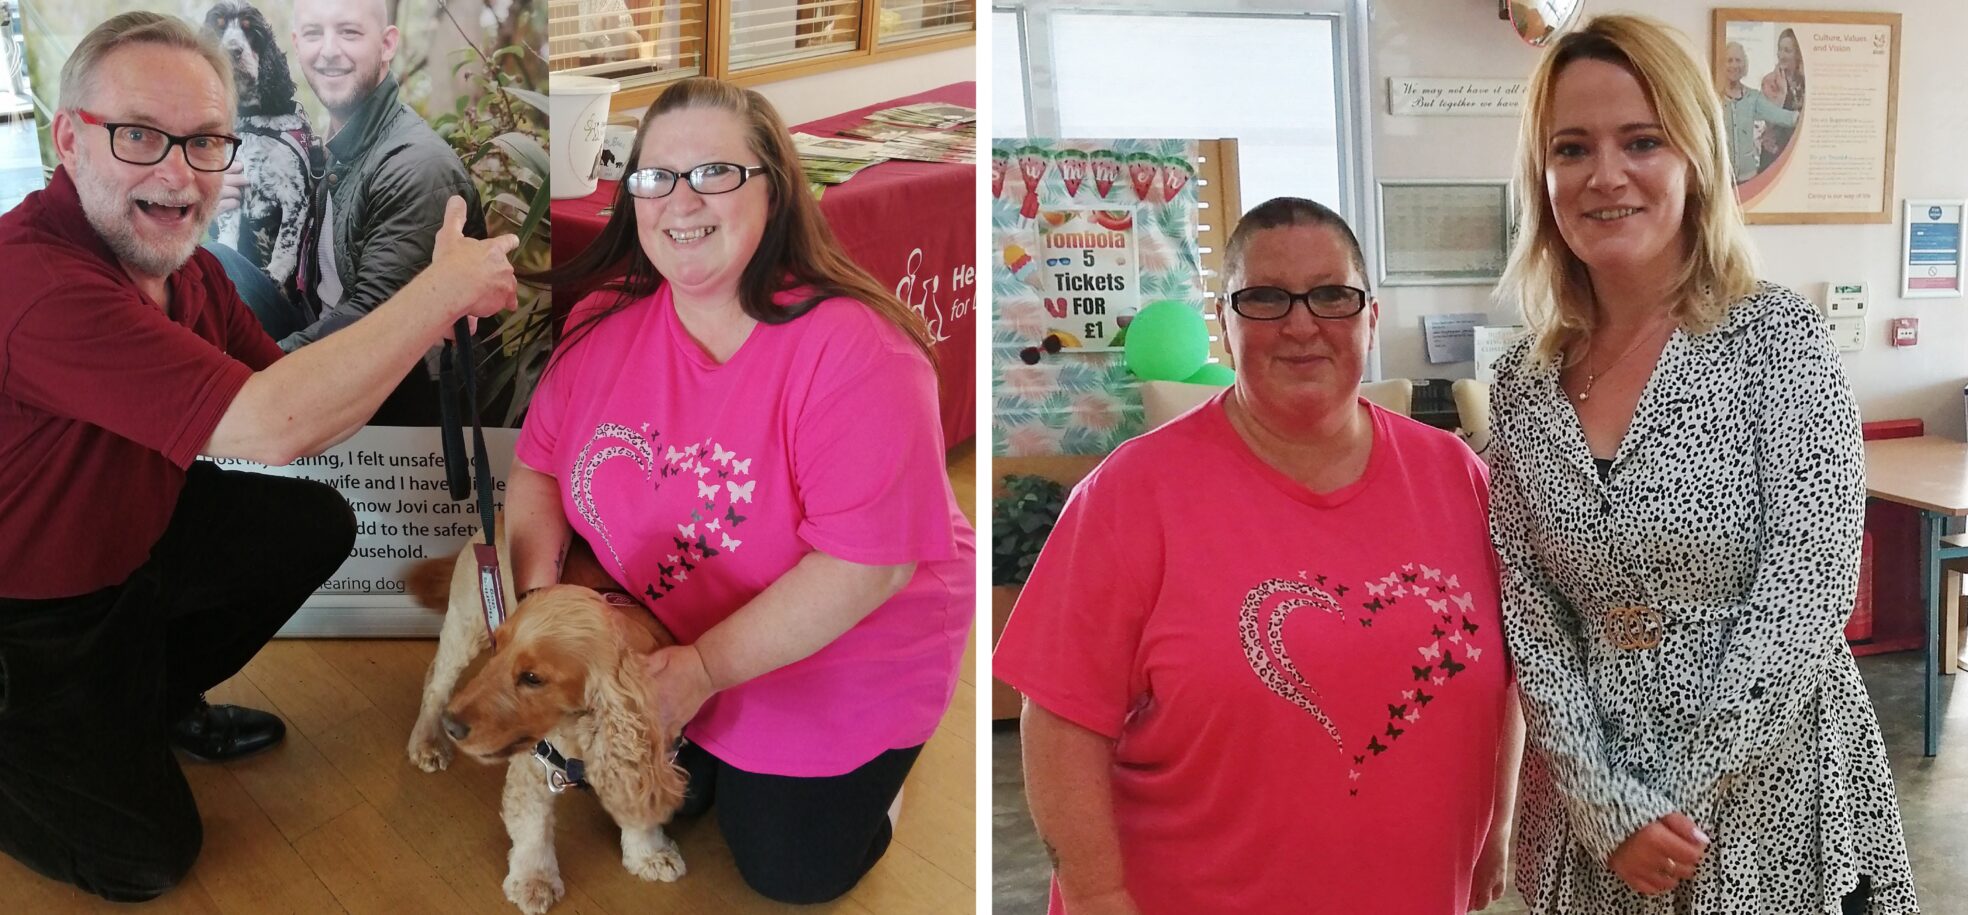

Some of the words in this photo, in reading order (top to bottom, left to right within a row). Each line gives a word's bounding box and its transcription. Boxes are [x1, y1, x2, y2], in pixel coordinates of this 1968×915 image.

[1844, 34, 1867, 42] Values
[1828, 44, 1851, 52] Vision
[1403, 82, 1416, 95] We
[1422, 89, 1443, 97] may
[1448, 86, 1464, 95] not
[1466, 84, 1489, 95] have
[1493, 86, 1502, 95] it
[1505, 84, 1520, 95] all
[1412, 97, 1435, 108] But
[1439, 98, 1476, 112] together
[1496, 97, 1520, 108] have
[1046, 231, 1126, 249] Tombola
[1082, 250, 1095, 267] 5
[952, 264, 976, 292] He
[1054, 273, 1125, 291] Tickets
[950, 299, 970, 321] for
[1073, 298, 1106, 315] FOR
[1084, 321, 1104, 339] £1
[289, 453, 344, 469] earing,
[348, 451, 353, 465] I
[357, 450, 385, 467] felt
[389, 452, 445, 468] unsafe
[325, 474, 361, 490] wife
[364, 475, 396, 491] and
[400, 476, 405, 490] I
[409, 477, 449, 491] have
[395, 499, 428, 514] Jovi
[428, 503, 462, 514] can
[466, 502, 504, 515] alrt
[356, 521, 377, 536] dd
[380, 523, 398, 536] to
[402, 522, 430, 537] the
[349, 544, 429, 559] ousehold.
[319, 576, 371, 593] earing
[375, 577, 405, 593] dog
